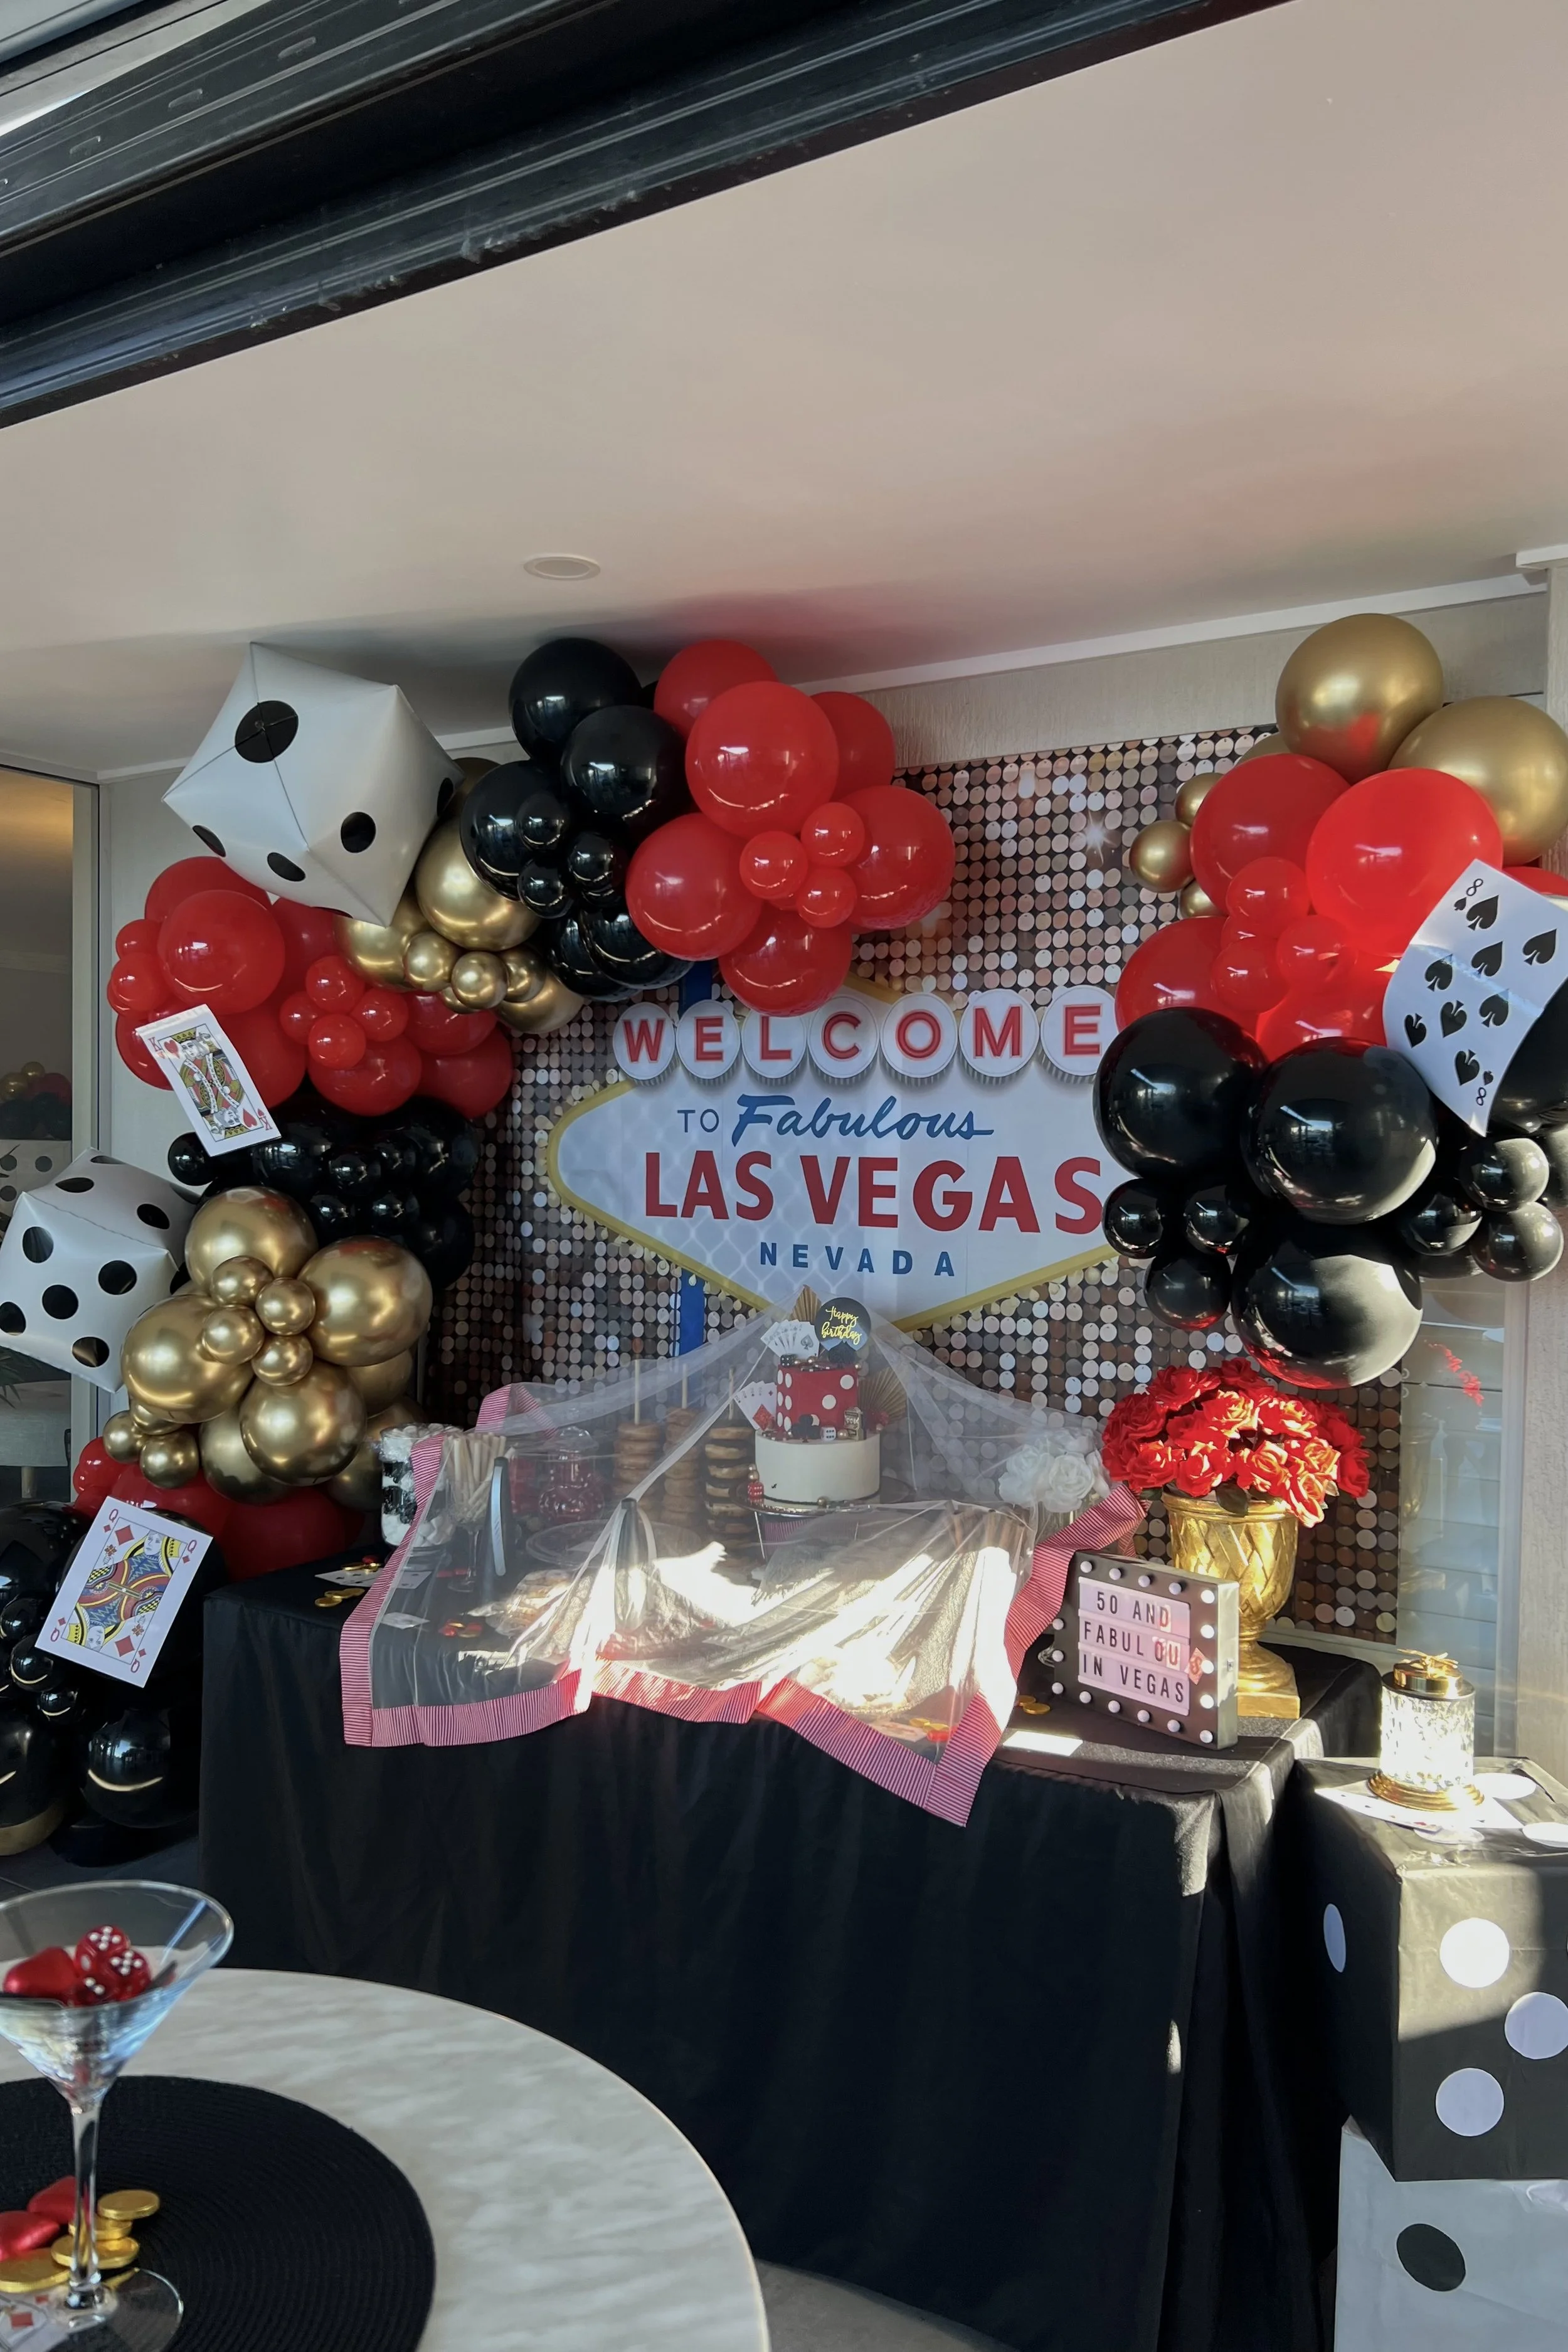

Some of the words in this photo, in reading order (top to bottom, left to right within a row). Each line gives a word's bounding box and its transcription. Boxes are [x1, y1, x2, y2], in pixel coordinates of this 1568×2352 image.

[147, 1036, 162, 1052] K
[623, 1004, 1102, 1063] WELCOME
[677, 1109, 720, 1133] TO
[730, 1093, 995, 1147] Fabulous
[645, 1150, 774, 1221] LAS
[799, 1156, 1103, 1235] VEGAS
[760, 1242, 955, 1277] NEVADA
[825, 1305, 859, 1328] Happy
[109, 1508, 119, 1523] Q
[187, 1539, 197, 1554] Q
[1097, 1591, 1118, 1614] 50
[1132, 1600, 1169, 1628] AND
[1083, 1653, 1103, 1677] IN
[1120, 1664, 1184, 1703] VEGAS
